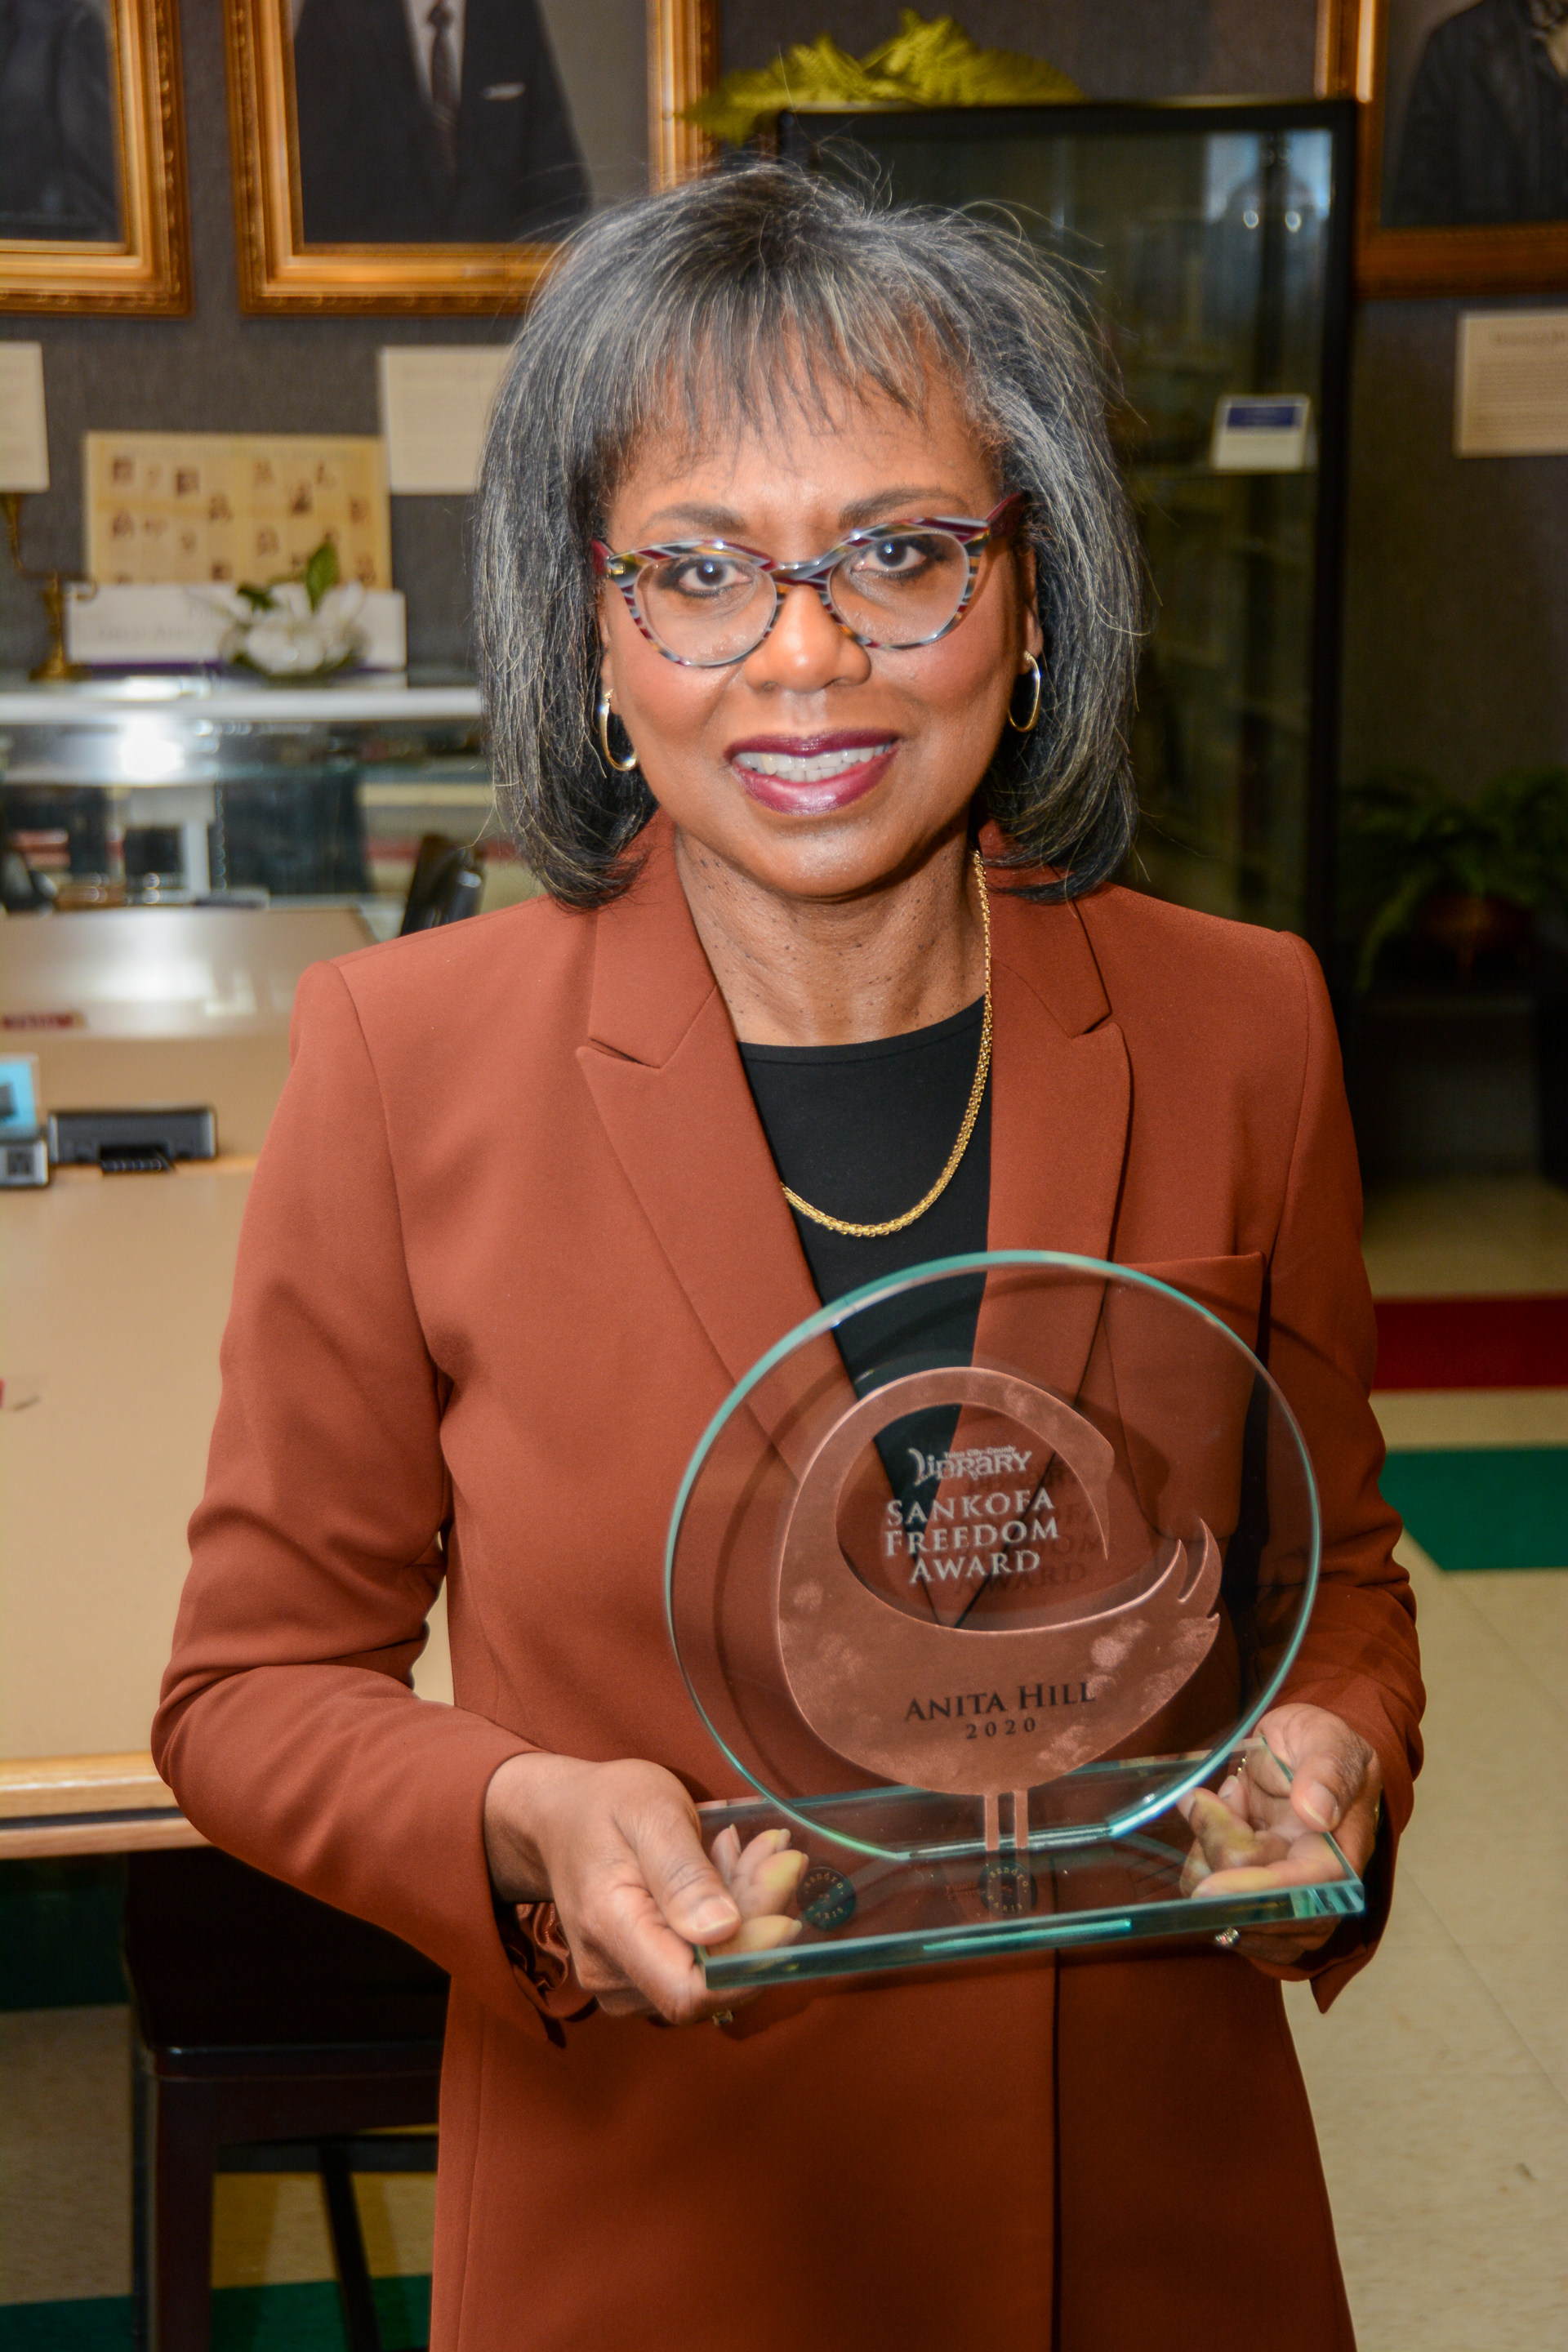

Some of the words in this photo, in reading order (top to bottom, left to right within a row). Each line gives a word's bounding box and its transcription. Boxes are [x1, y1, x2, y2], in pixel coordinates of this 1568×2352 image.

[886, 1486, 1055, 1526] SANKOFA
[885, 1517, 1060, 1557] FREEDOM
[908, 1549, 1040, 1584] AWARD
[904, 1691, 1007, 1722] ANITA
[1018, 1682, 1096, 1710] HILL
[966, 1717, 1036, 1740] 2020
